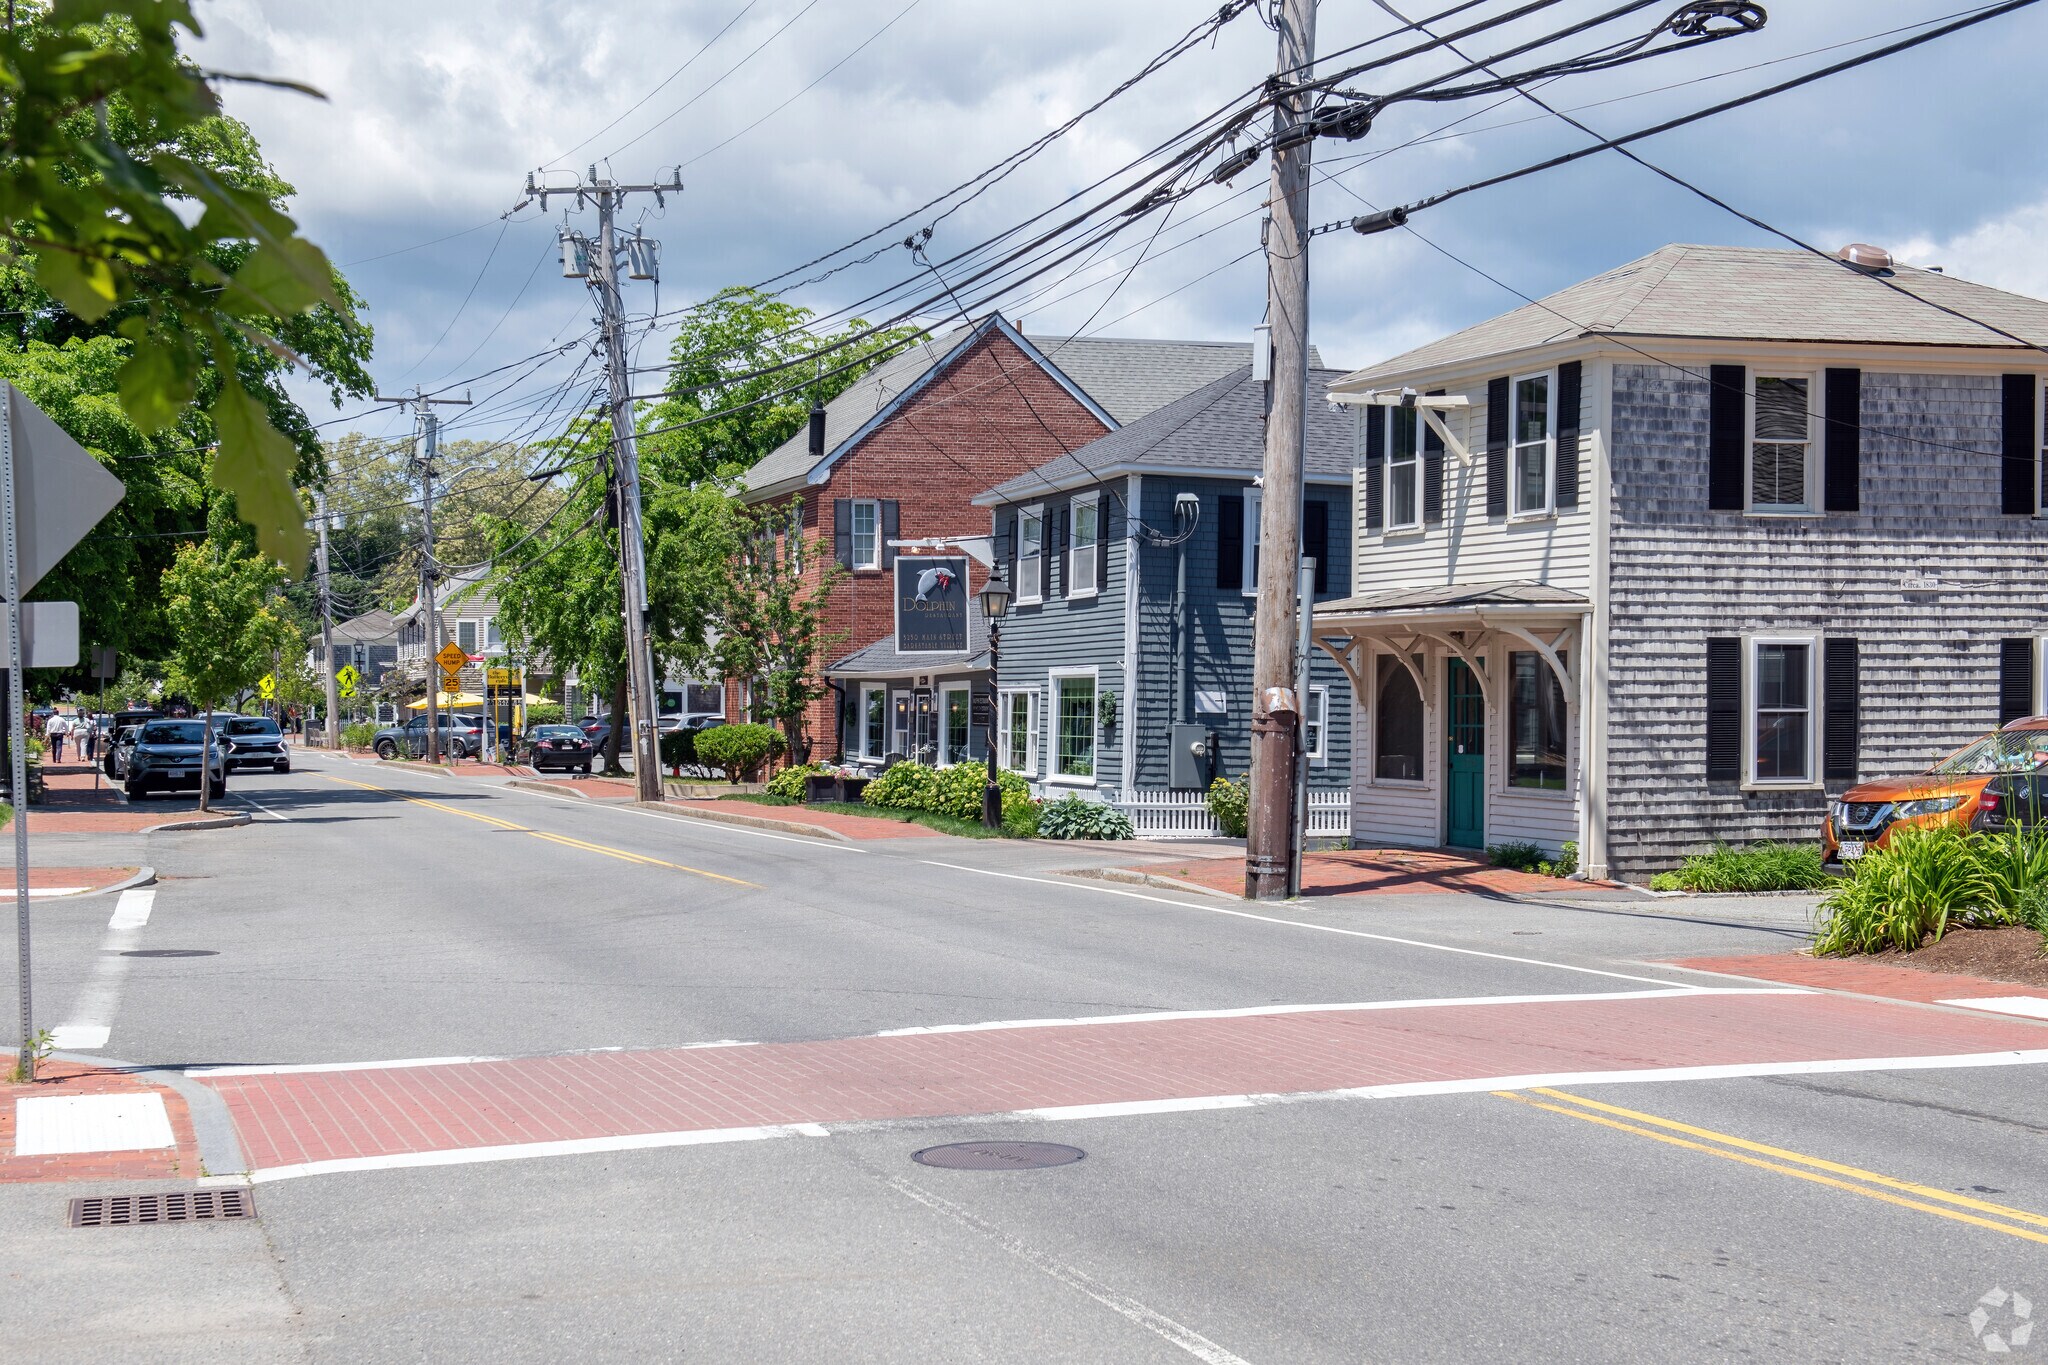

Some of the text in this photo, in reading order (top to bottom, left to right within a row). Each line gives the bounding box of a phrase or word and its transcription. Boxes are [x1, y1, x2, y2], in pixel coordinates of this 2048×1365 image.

[902, 597, 956, 611] DOLPHIN
[921, 633, 937, 641] MAIN
[939, 633, 963, 641] STREET
[940, 641, 963, 649] VILLAGE
[445, 678, 459, 686] 25
